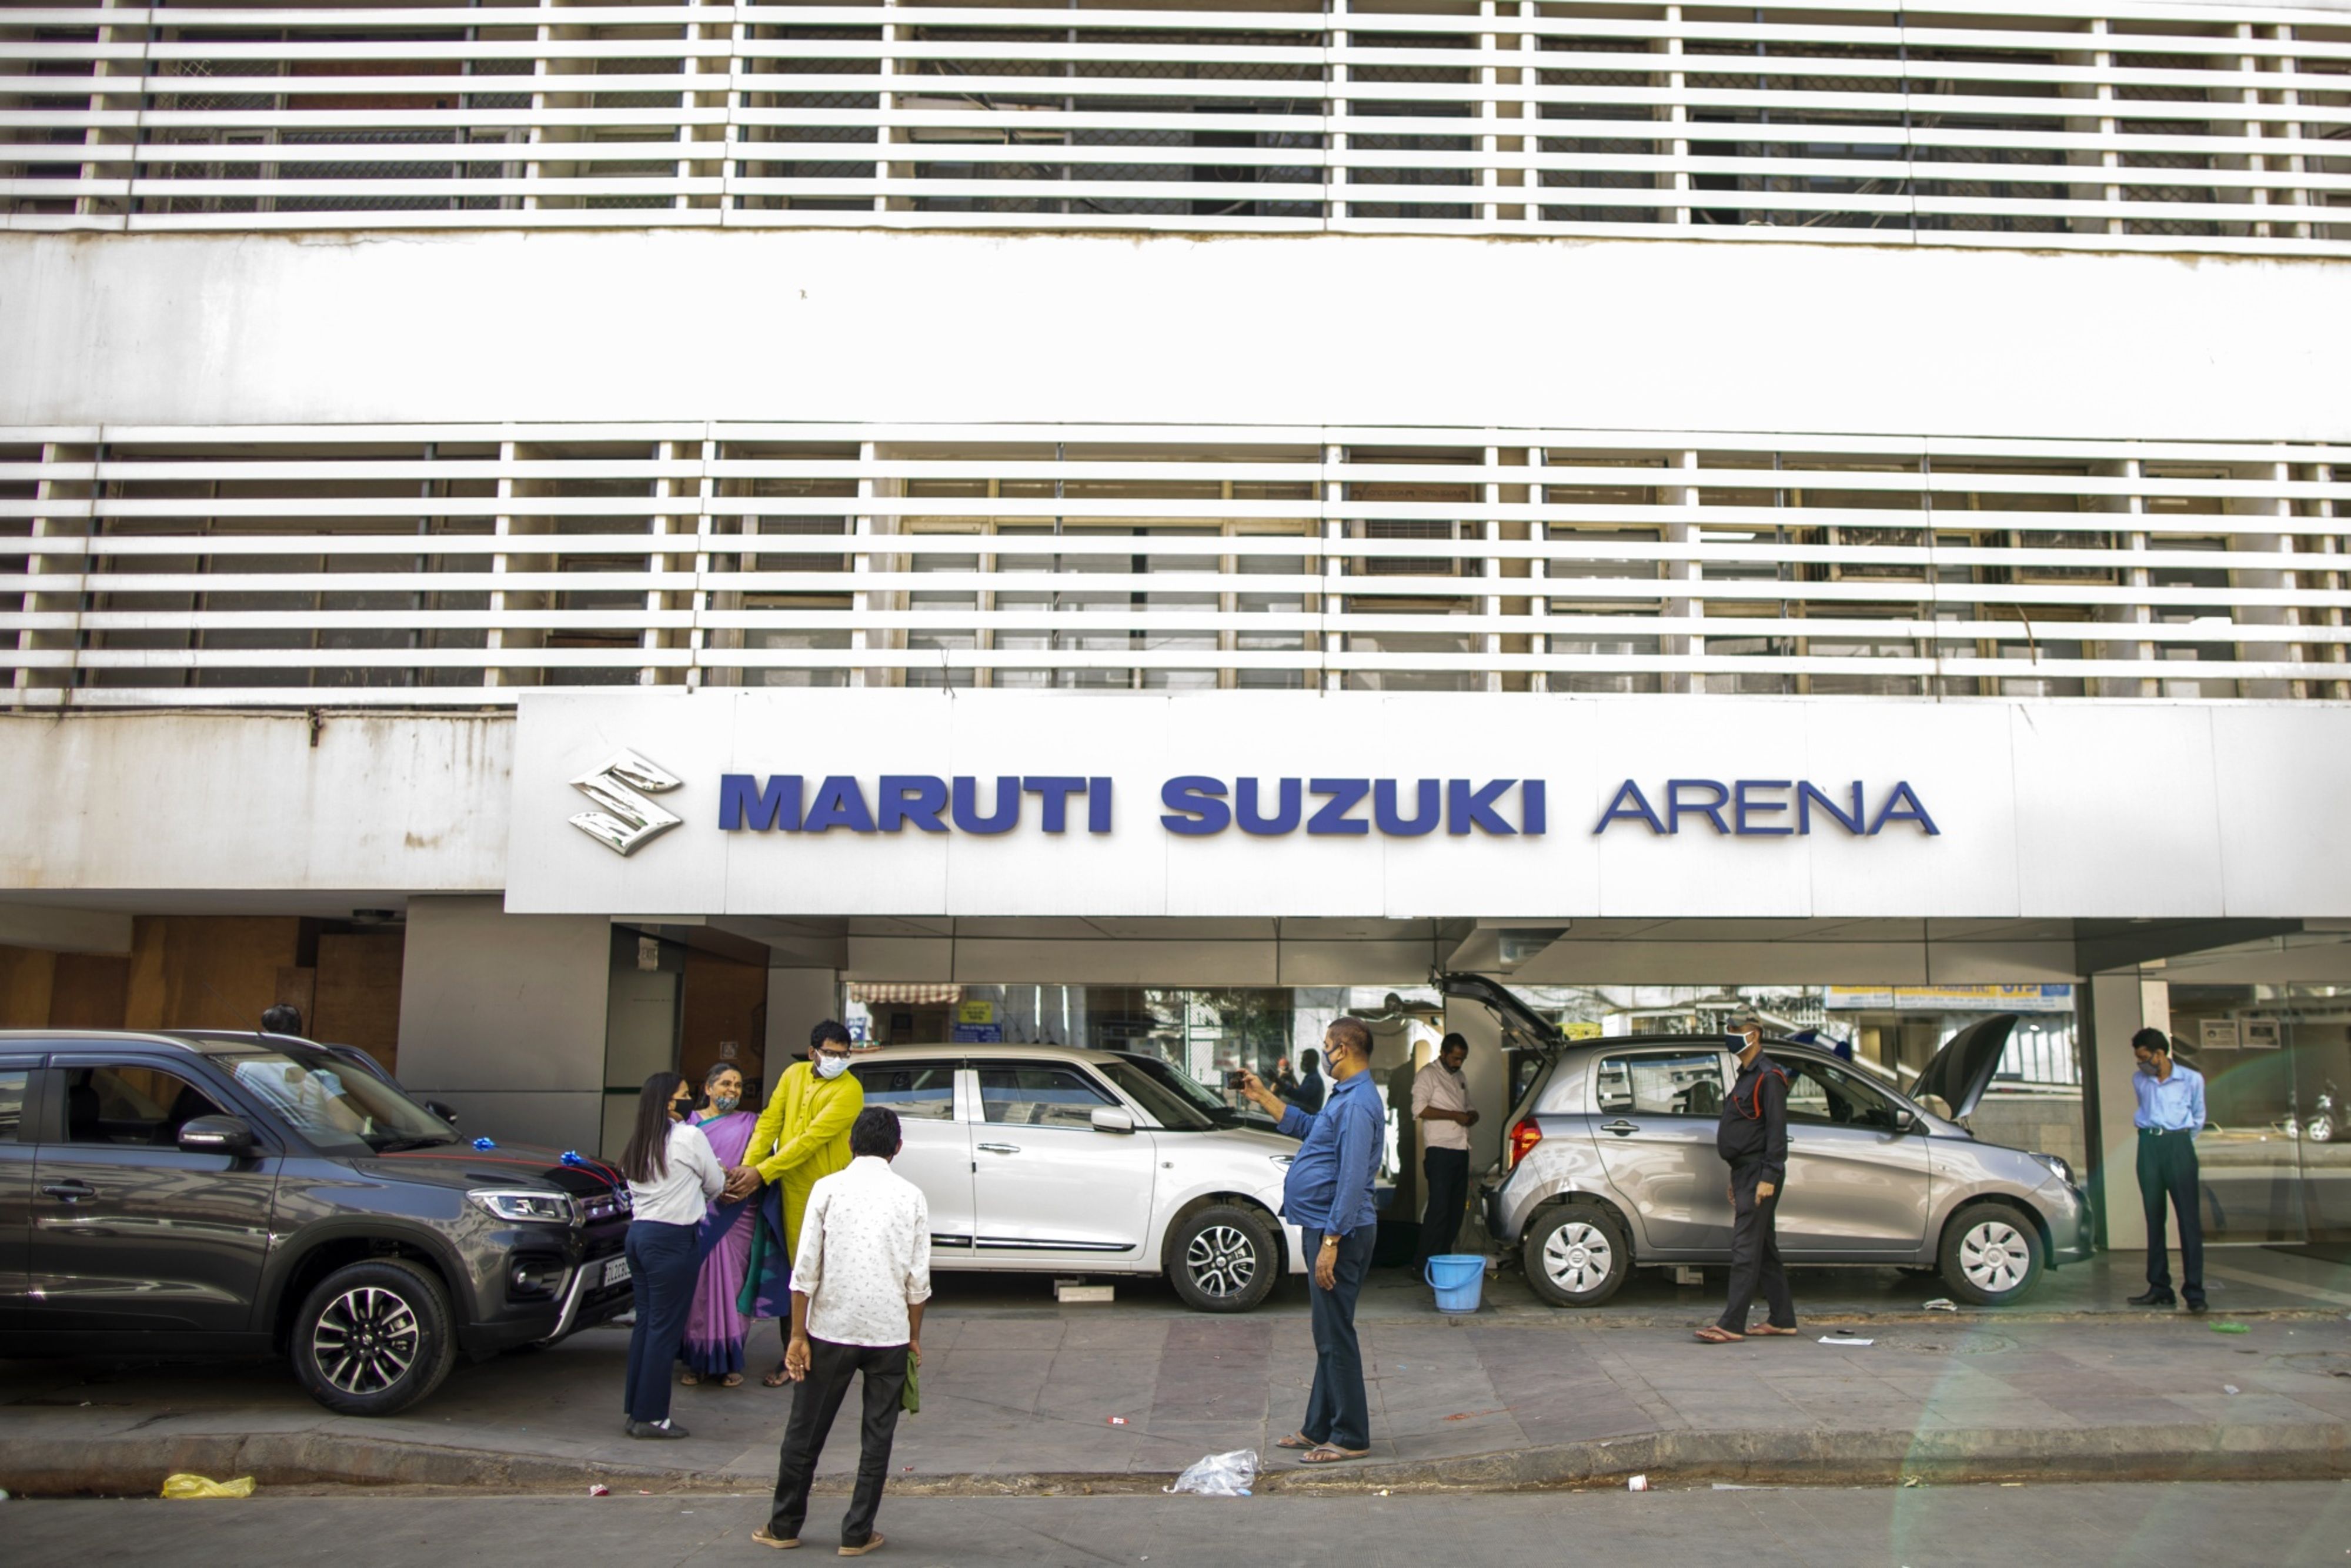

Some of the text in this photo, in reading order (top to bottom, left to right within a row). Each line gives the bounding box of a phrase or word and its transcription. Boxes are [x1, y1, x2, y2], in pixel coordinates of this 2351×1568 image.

[719, 774, 1941, 836] MARUTI SUZUKI ARENA
